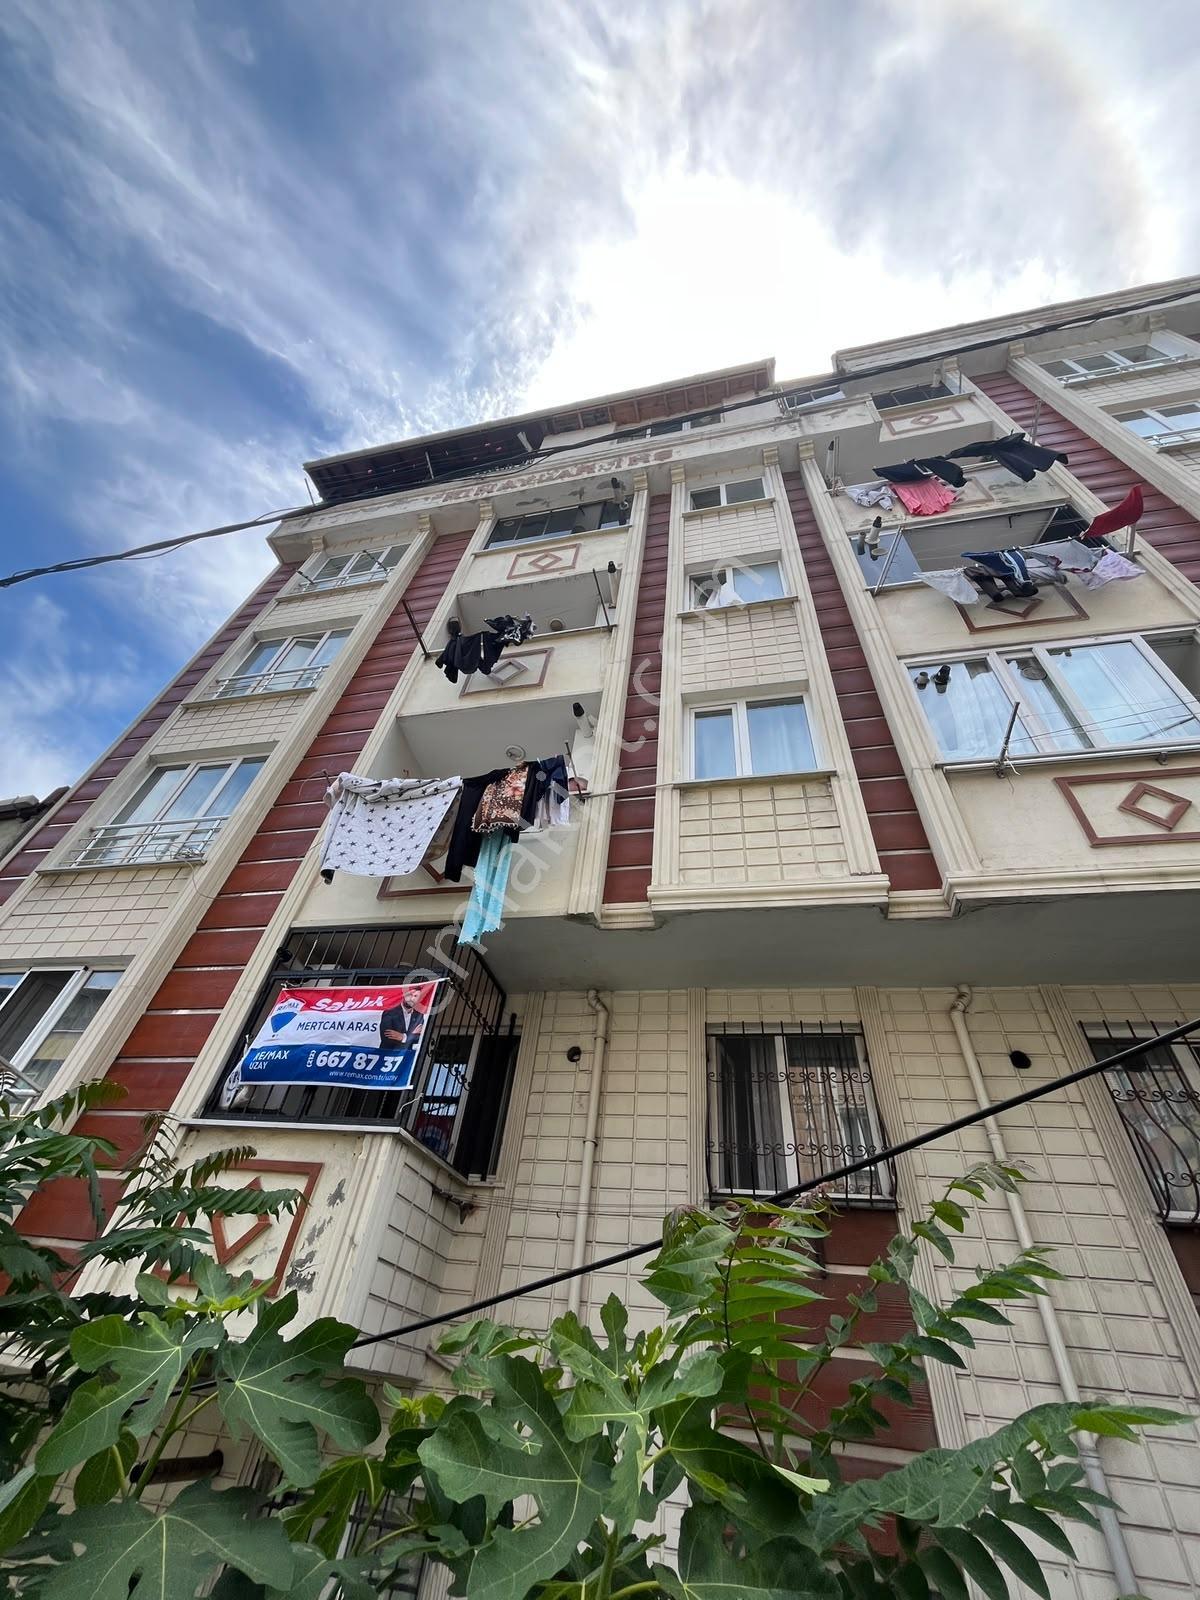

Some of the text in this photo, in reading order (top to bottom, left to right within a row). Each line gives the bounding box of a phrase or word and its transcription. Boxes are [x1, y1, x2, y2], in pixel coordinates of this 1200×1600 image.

[296, 1021, 378, 1033] MERTCAN ARAS
[248, 1061, 268, 1070] UZAY
[316, 1051, 352, 1068] 667
[353, 1052, 380, 1071] 87
[380, 1055, 404, 1073] 37
